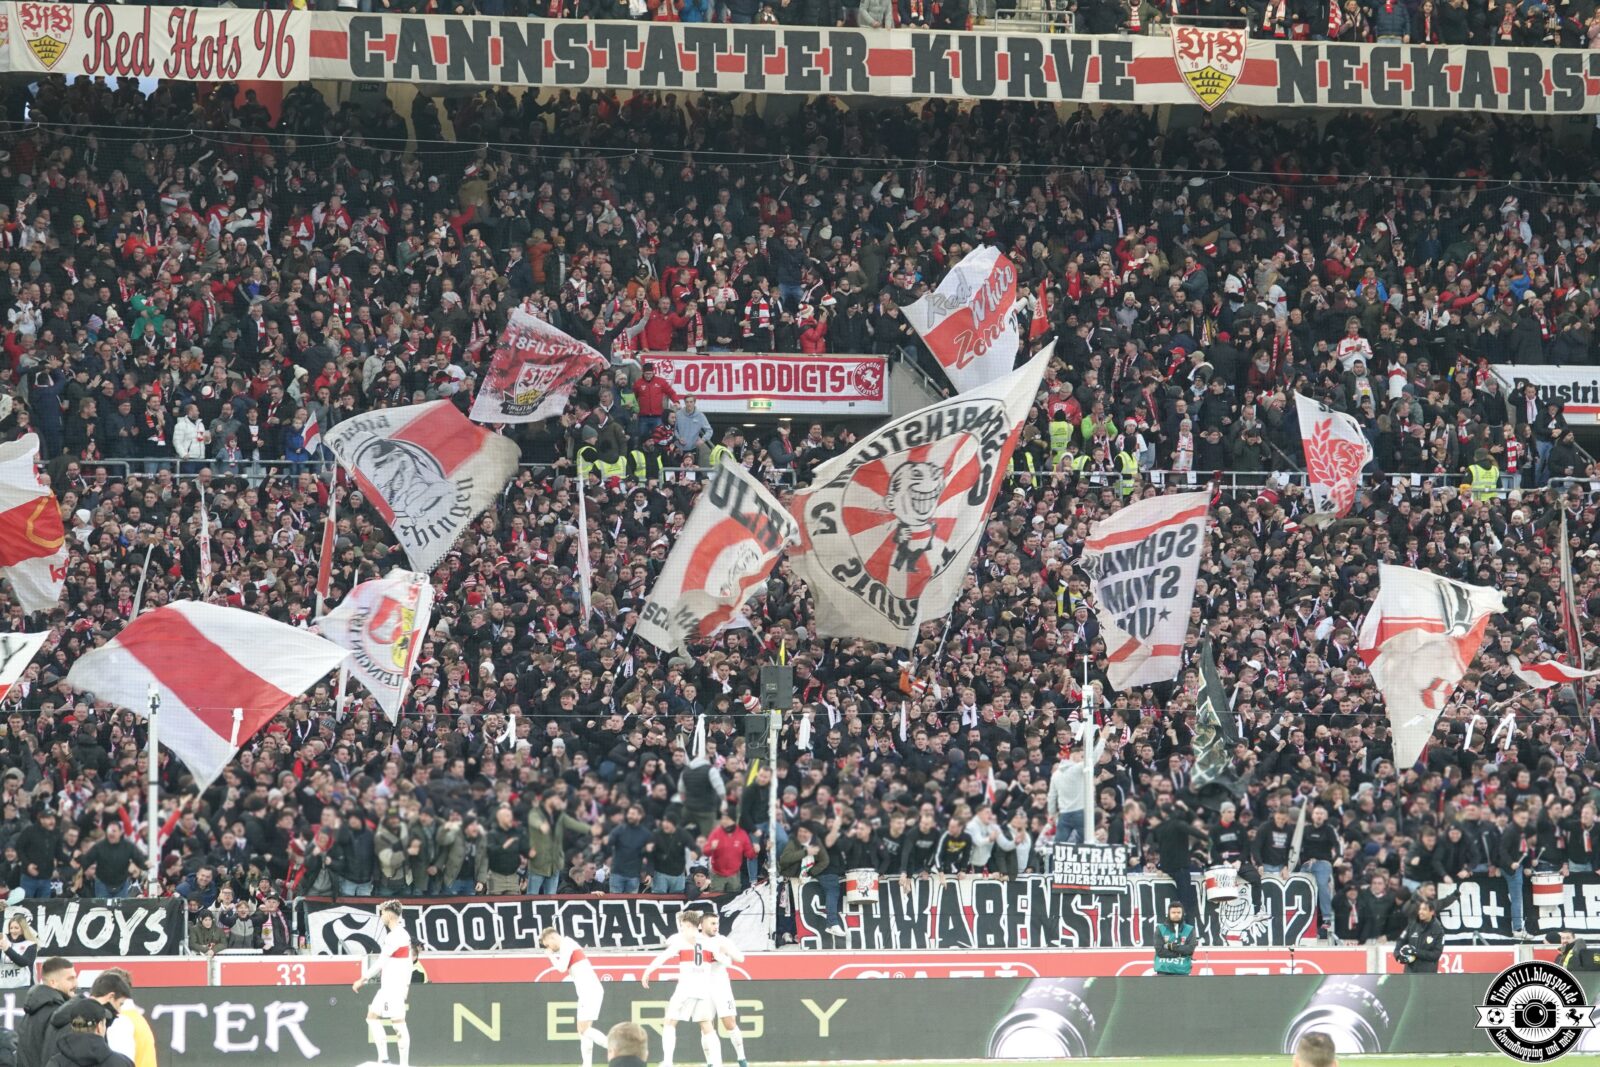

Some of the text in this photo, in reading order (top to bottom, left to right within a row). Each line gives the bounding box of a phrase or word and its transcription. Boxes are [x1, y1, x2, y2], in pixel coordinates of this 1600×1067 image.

[83, 4, 295, 80] Red Hots 96
[1177, 28, 1243, 63] VfB
[349, 15, 870, 92] CANNSTATTER
[912, 33, 1135, 101] KURVE
[924, 266, 972, 330] Red
[970, 265, 1014, 330] White
[684, 363, 846, 393] 0711 ADDICTS
[1513, 378, 1599, 404] ustri
[1054, 845, 1126, 864] ULTRAS
[1053, 861, 1127, 876] BEDEUTET
[1053, 873, 1127, 886] WIDERSTAND
[694, 943, 703, 967] 6
[1437, 954, 1464, 974] 34
[276, 963, 306, 986] 33
